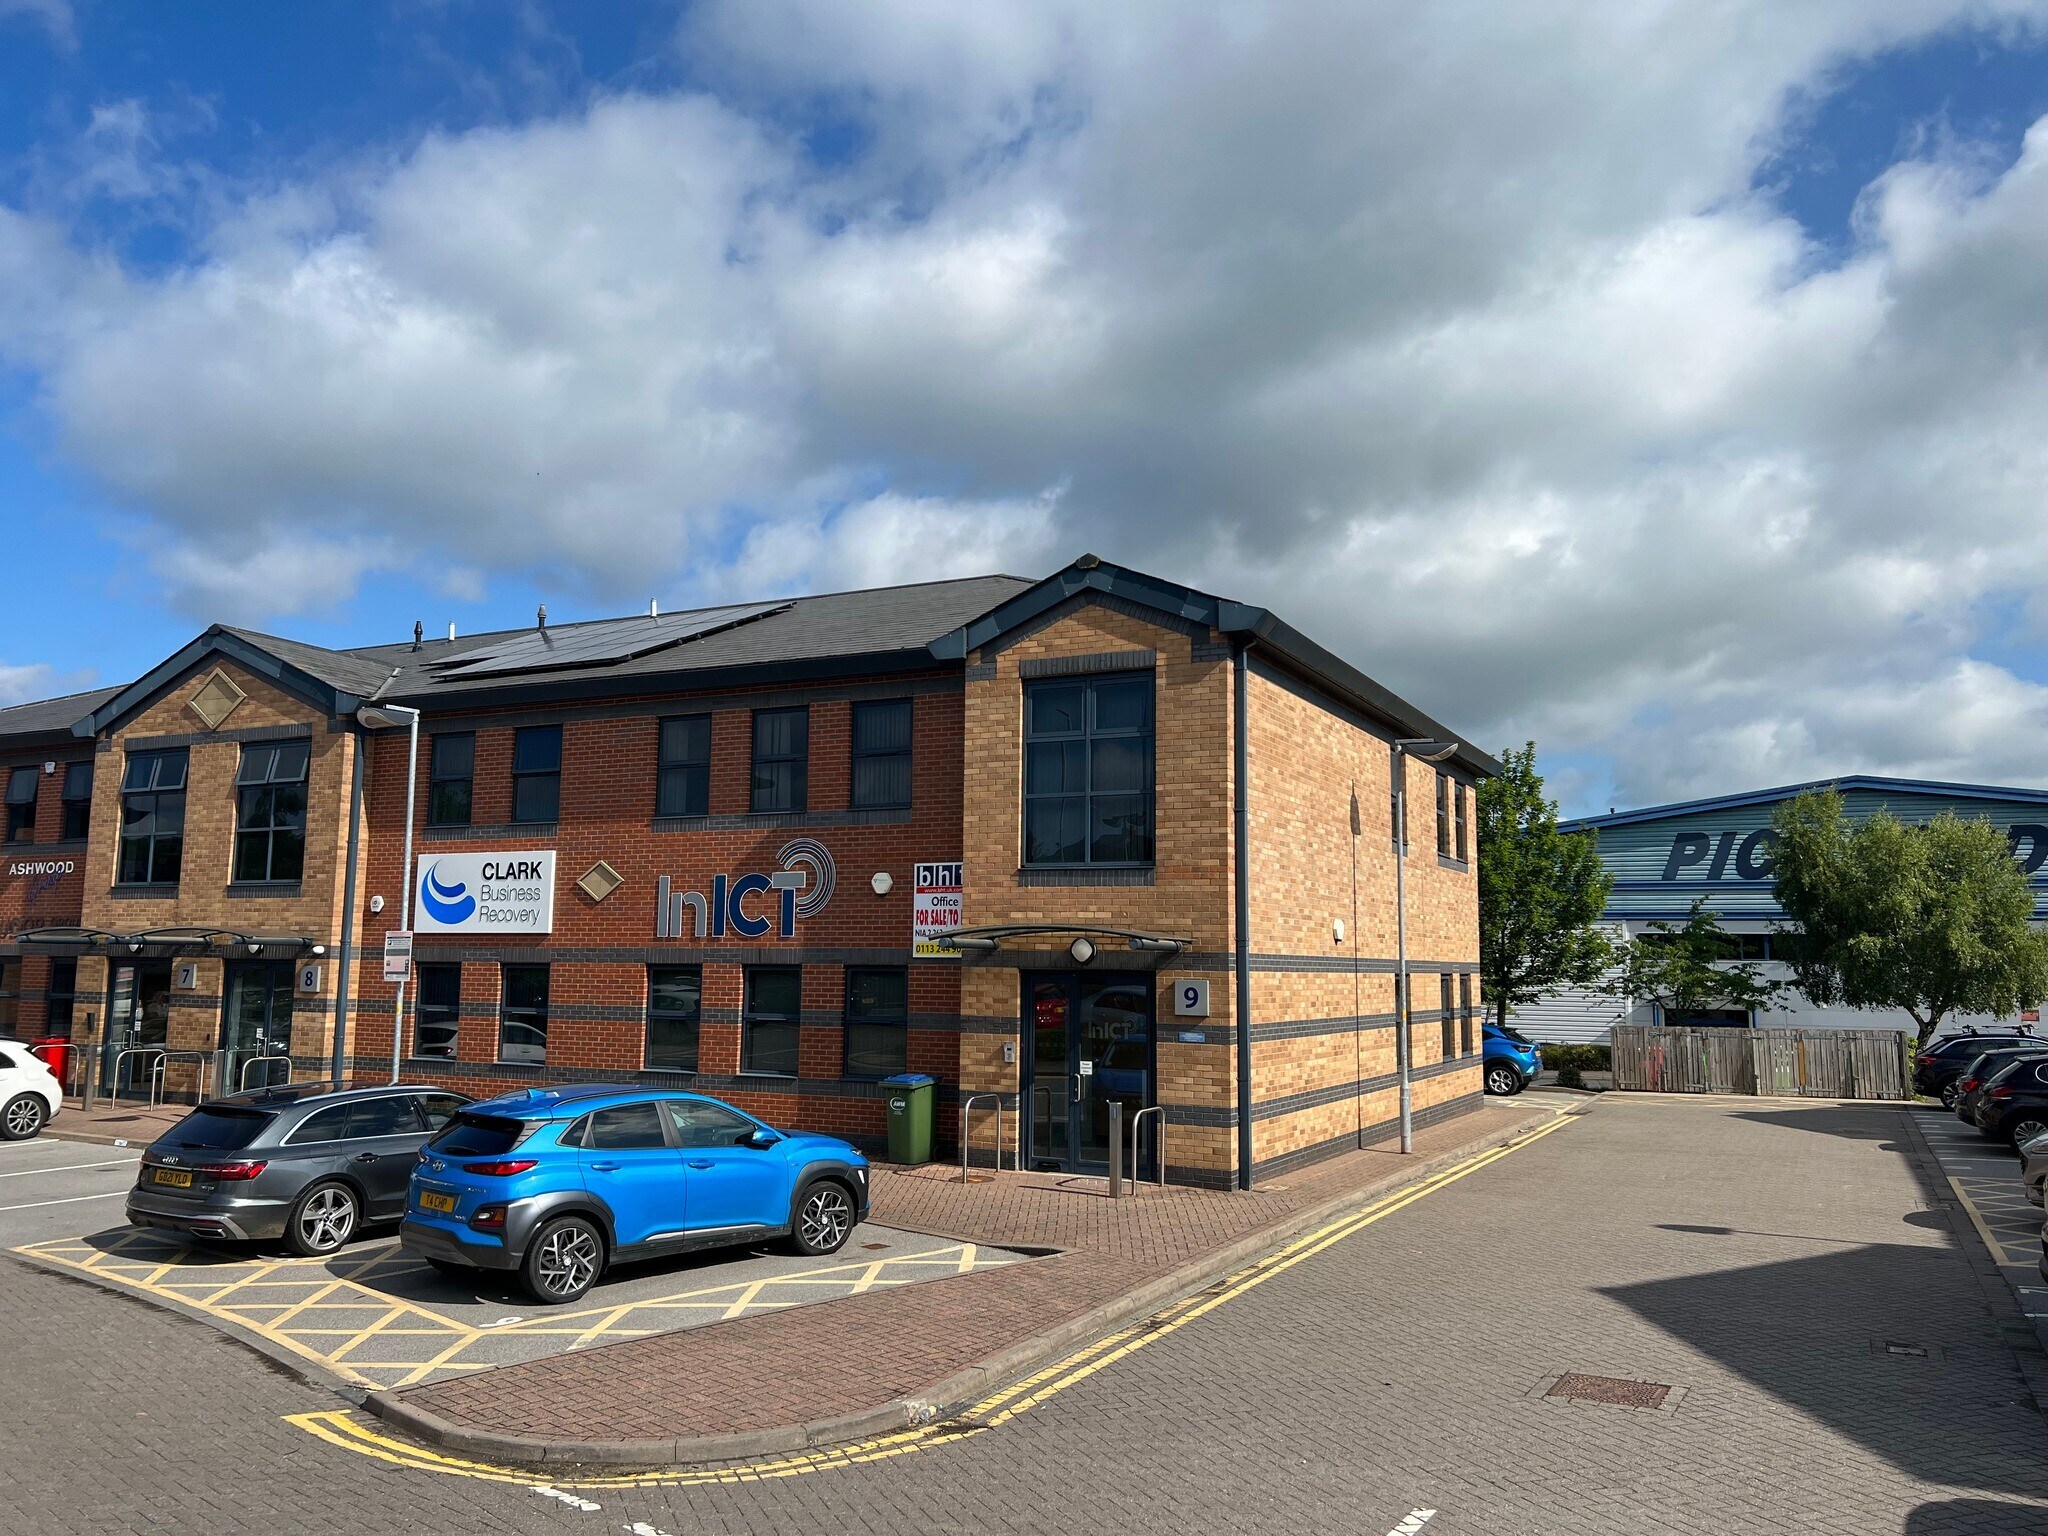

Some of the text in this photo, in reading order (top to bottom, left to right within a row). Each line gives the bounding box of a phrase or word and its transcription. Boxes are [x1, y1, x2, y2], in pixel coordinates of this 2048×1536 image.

[9, 861, 74, 875] ASHWOOD
[482, 861, 543, 880] CLARK
[481, 884, 541, 901] Business
[657, 871, 807, 938] InICT
[931, 896, 959, 907] Office
[479, 905, 541, 927] Recovery
[916, 909, 929, 926] FOR
[916, 944, 935, 953] 0113
[181, 969, 190, 984] 7
[304, 970, 314, 987] 8
[1183, 986, 1199, 1009] 9
